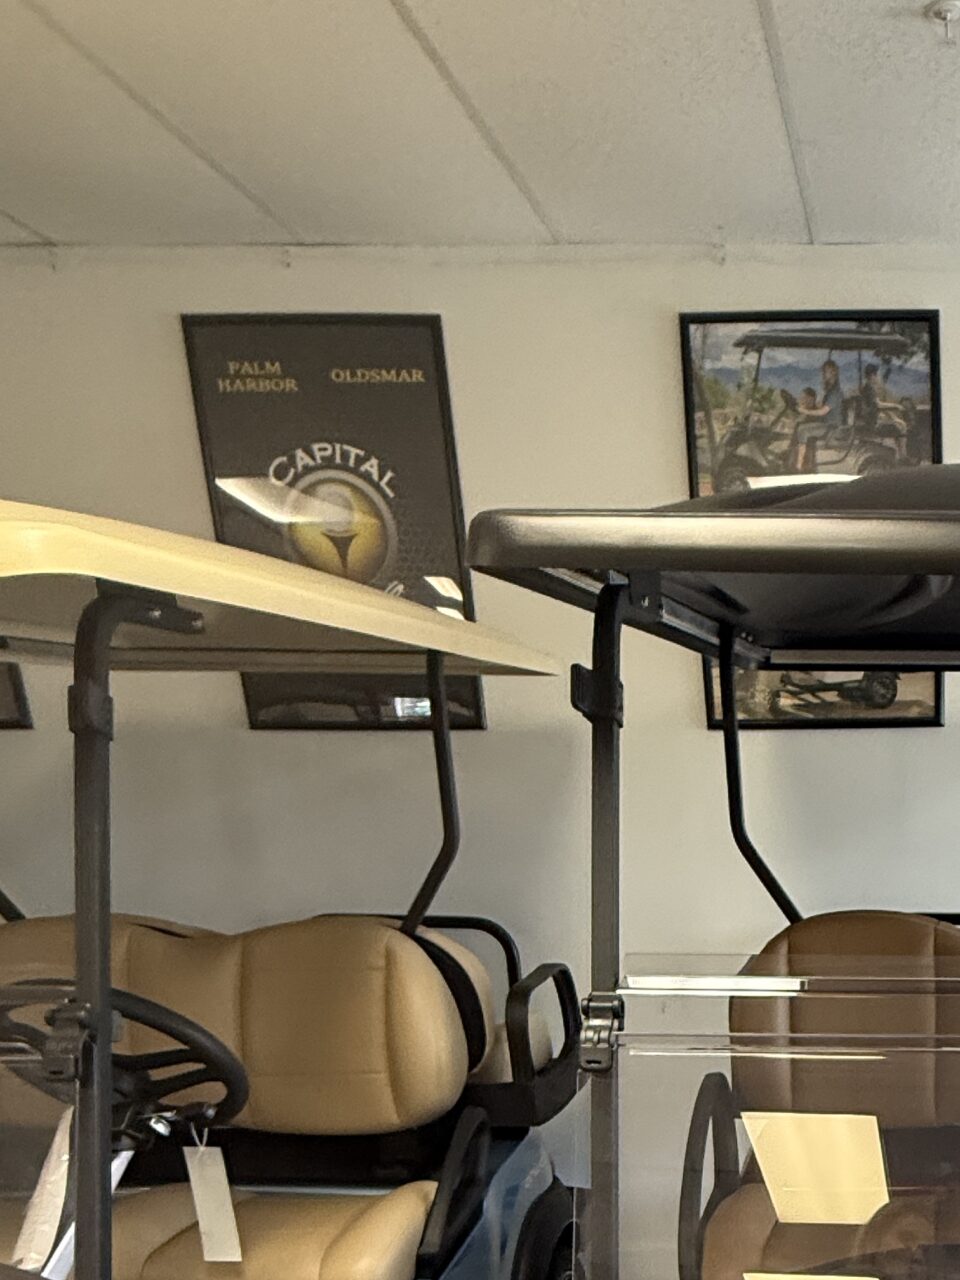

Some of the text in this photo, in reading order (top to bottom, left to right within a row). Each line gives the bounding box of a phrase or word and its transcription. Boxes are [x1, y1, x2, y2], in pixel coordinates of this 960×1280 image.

[228, 361, 281, 375] PALM
[330, 369, 425, 383] OLDSMAR
[218, 378, 298, 392] HARBOR
[268, 442, 396, 499] CAPITAL
